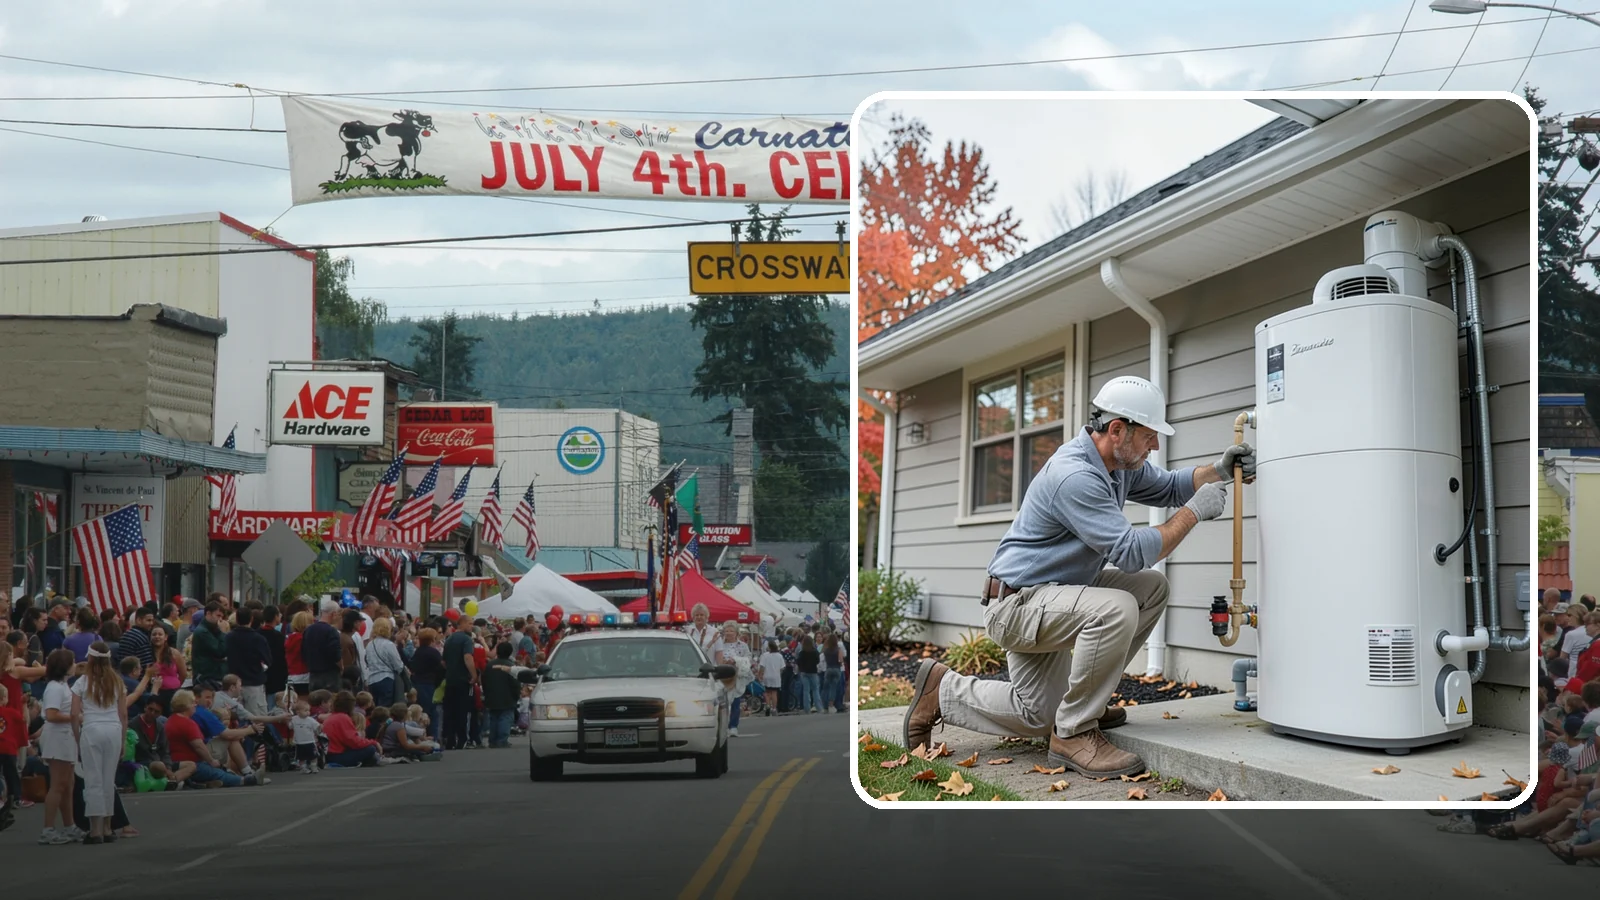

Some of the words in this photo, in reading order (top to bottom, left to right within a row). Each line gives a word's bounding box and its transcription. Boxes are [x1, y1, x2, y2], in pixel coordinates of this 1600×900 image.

[481, 140, 605, 192] JULY
[632, 150, 747, 198] 4th.
[696, 254, 850, 280] CROSSWA
[282, 380, 373, 420] ACE
[405, 409, 453, 422] CEDAR
[283, 421, 371, 437] Hardware
[416, 428, 477, 447] Coca-Cola
[96, 485, 124, 495] Vincent
[126, 486, 136, 495] de
[137, 486, 155, 496] Paul
[699, 535, 730, 543] GLASS
